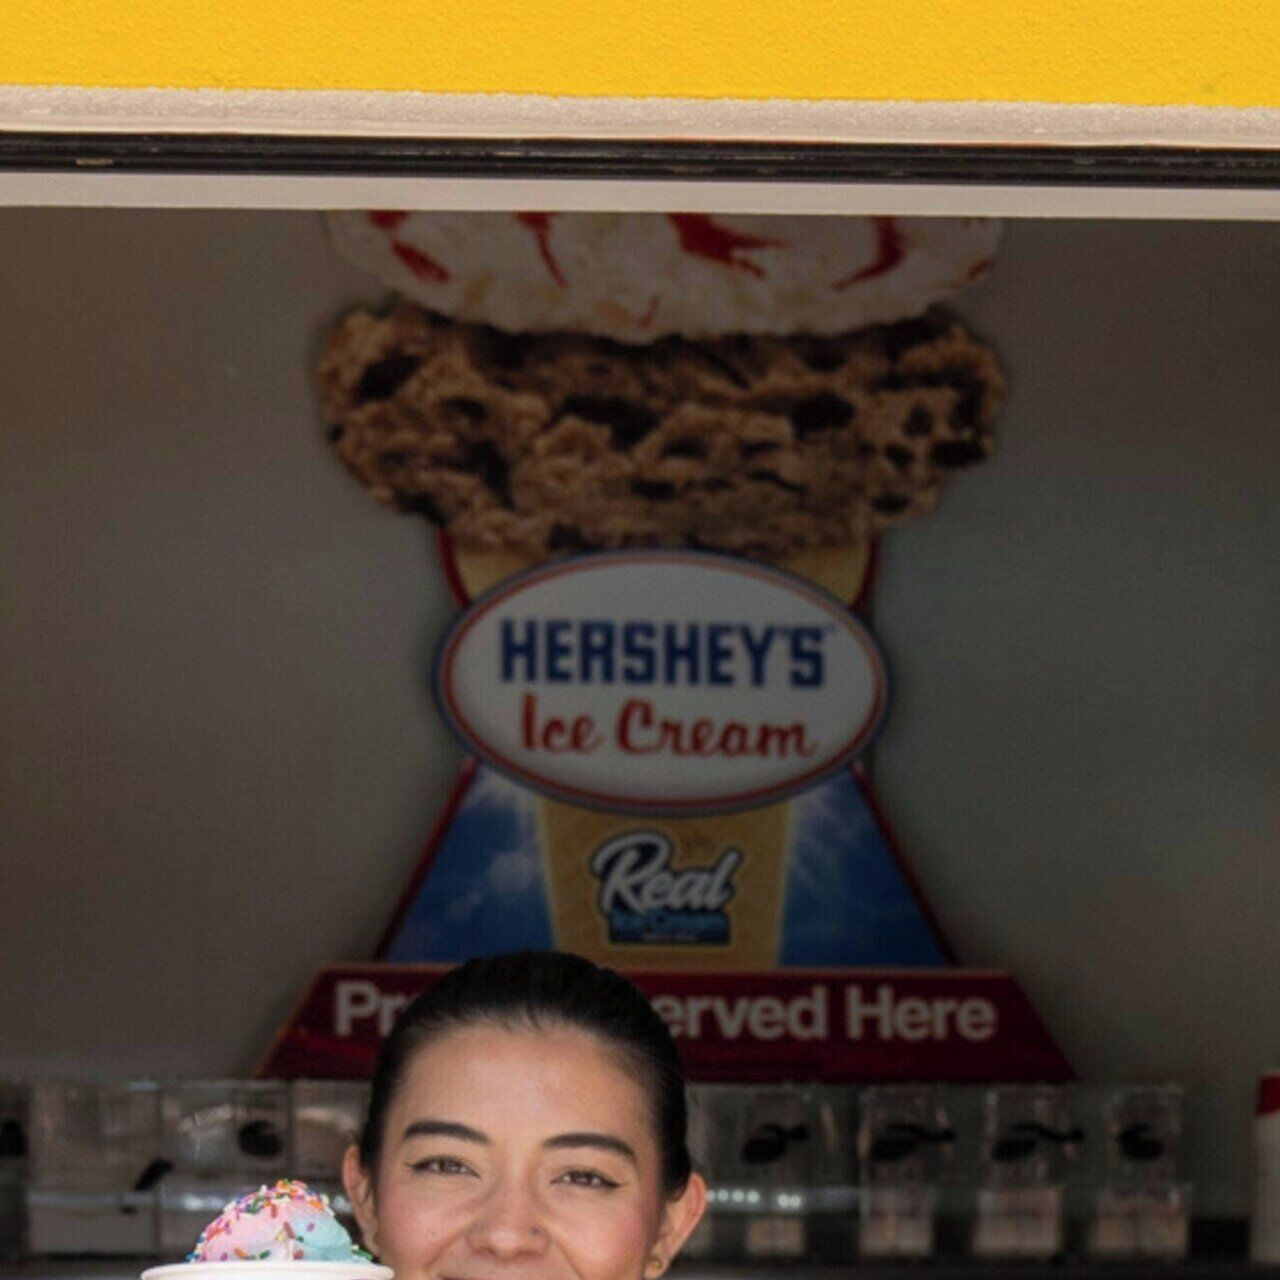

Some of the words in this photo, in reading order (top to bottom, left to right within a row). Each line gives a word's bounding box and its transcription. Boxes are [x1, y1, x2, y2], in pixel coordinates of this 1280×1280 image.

[499, 617, 826, 689] HERSHEY'S
[520, 692, 604, 752] Ice
[615, 696, 818, 758] Cream
[591, 831, 742, 914] Real
[667, 986, 826, 1039] erved
[845, 988, 995, 1041] Here
